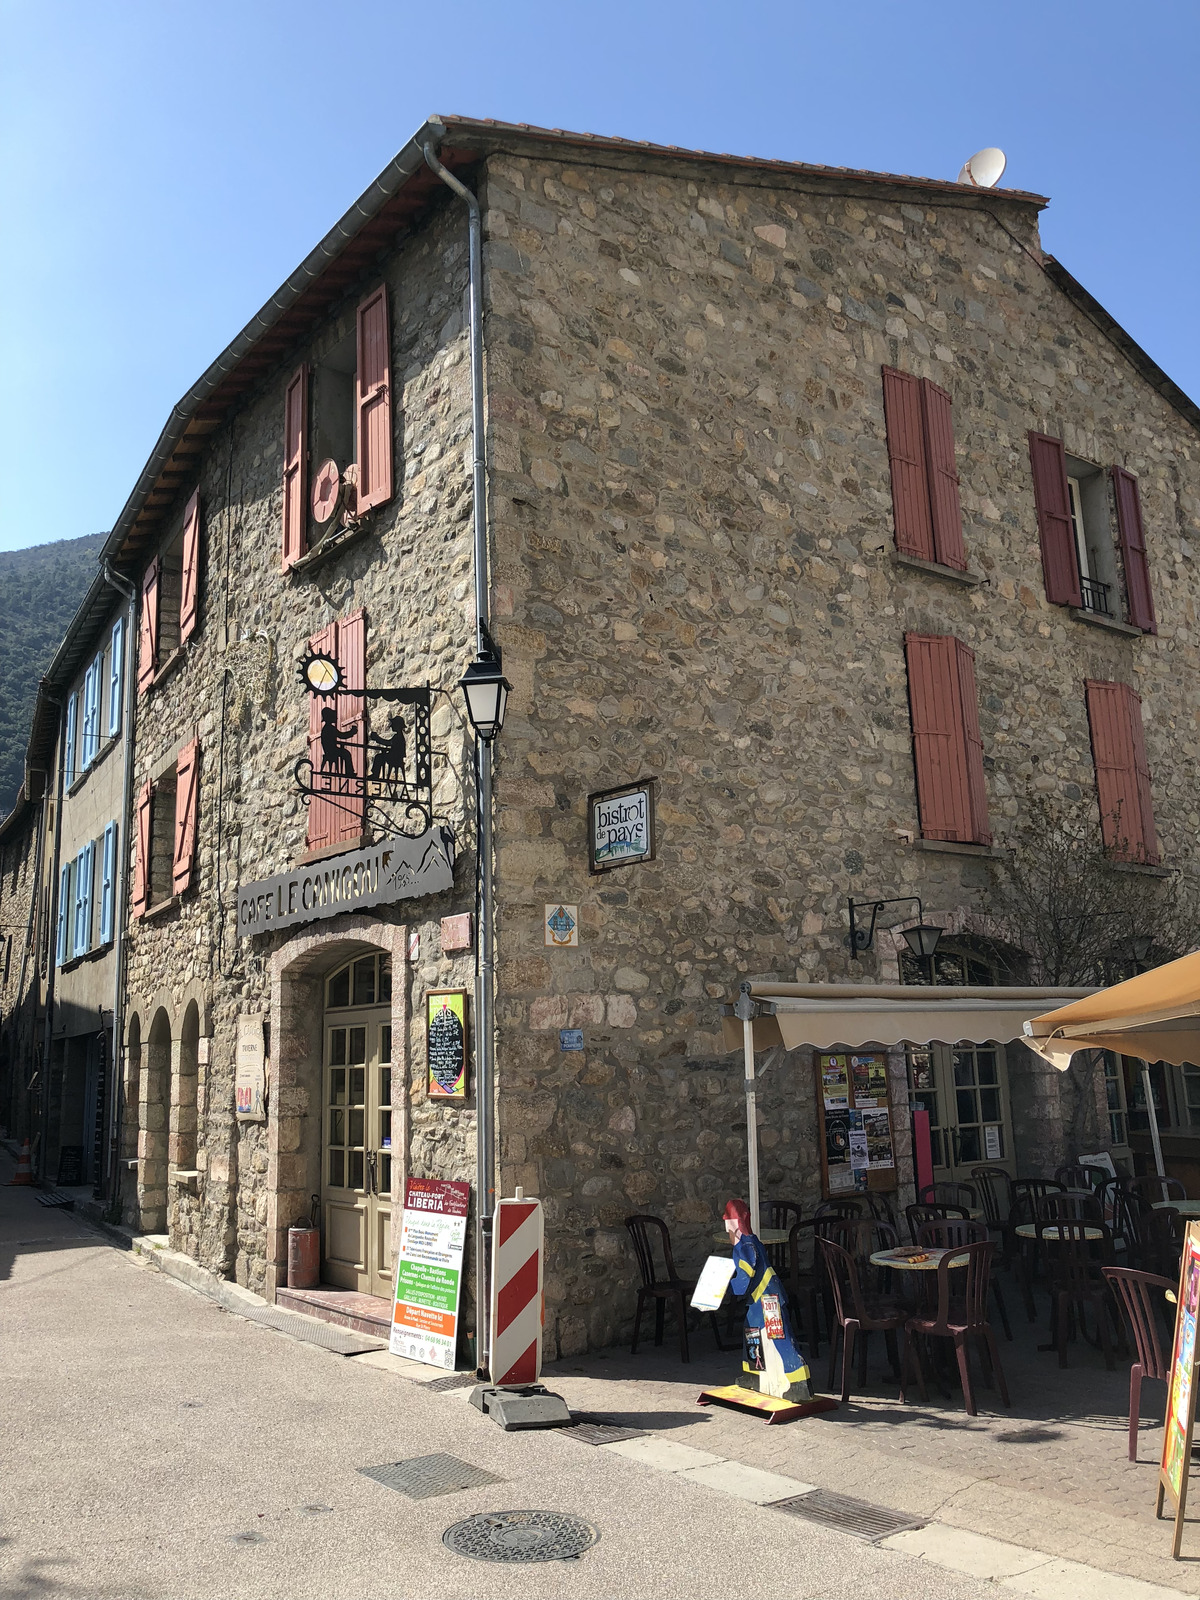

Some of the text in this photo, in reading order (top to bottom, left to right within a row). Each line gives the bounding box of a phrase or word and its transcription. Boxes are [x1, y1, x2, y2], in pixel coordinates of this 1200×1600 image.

[597, 798, 644, 828] bistrot
[597, 822, 644, 852] de pays
[240, 892, 273, 925] CAFE
[277, 880, 298, 917] LE
[302, 856, 379, 910] CANIGOU
[409, 1191, 444, 1200] CHATEAU-FORT
[407, 1197, 443, 1211] LIBERIA
[429, 1267, 446, 1276] Bastions
[421, 1273, 435, 1282] Chemin
[441, 1277, 454, 1286] Ronde
[764, 1302, 777, 1310] 2017
[765, 1316, 782, 1329] petit
